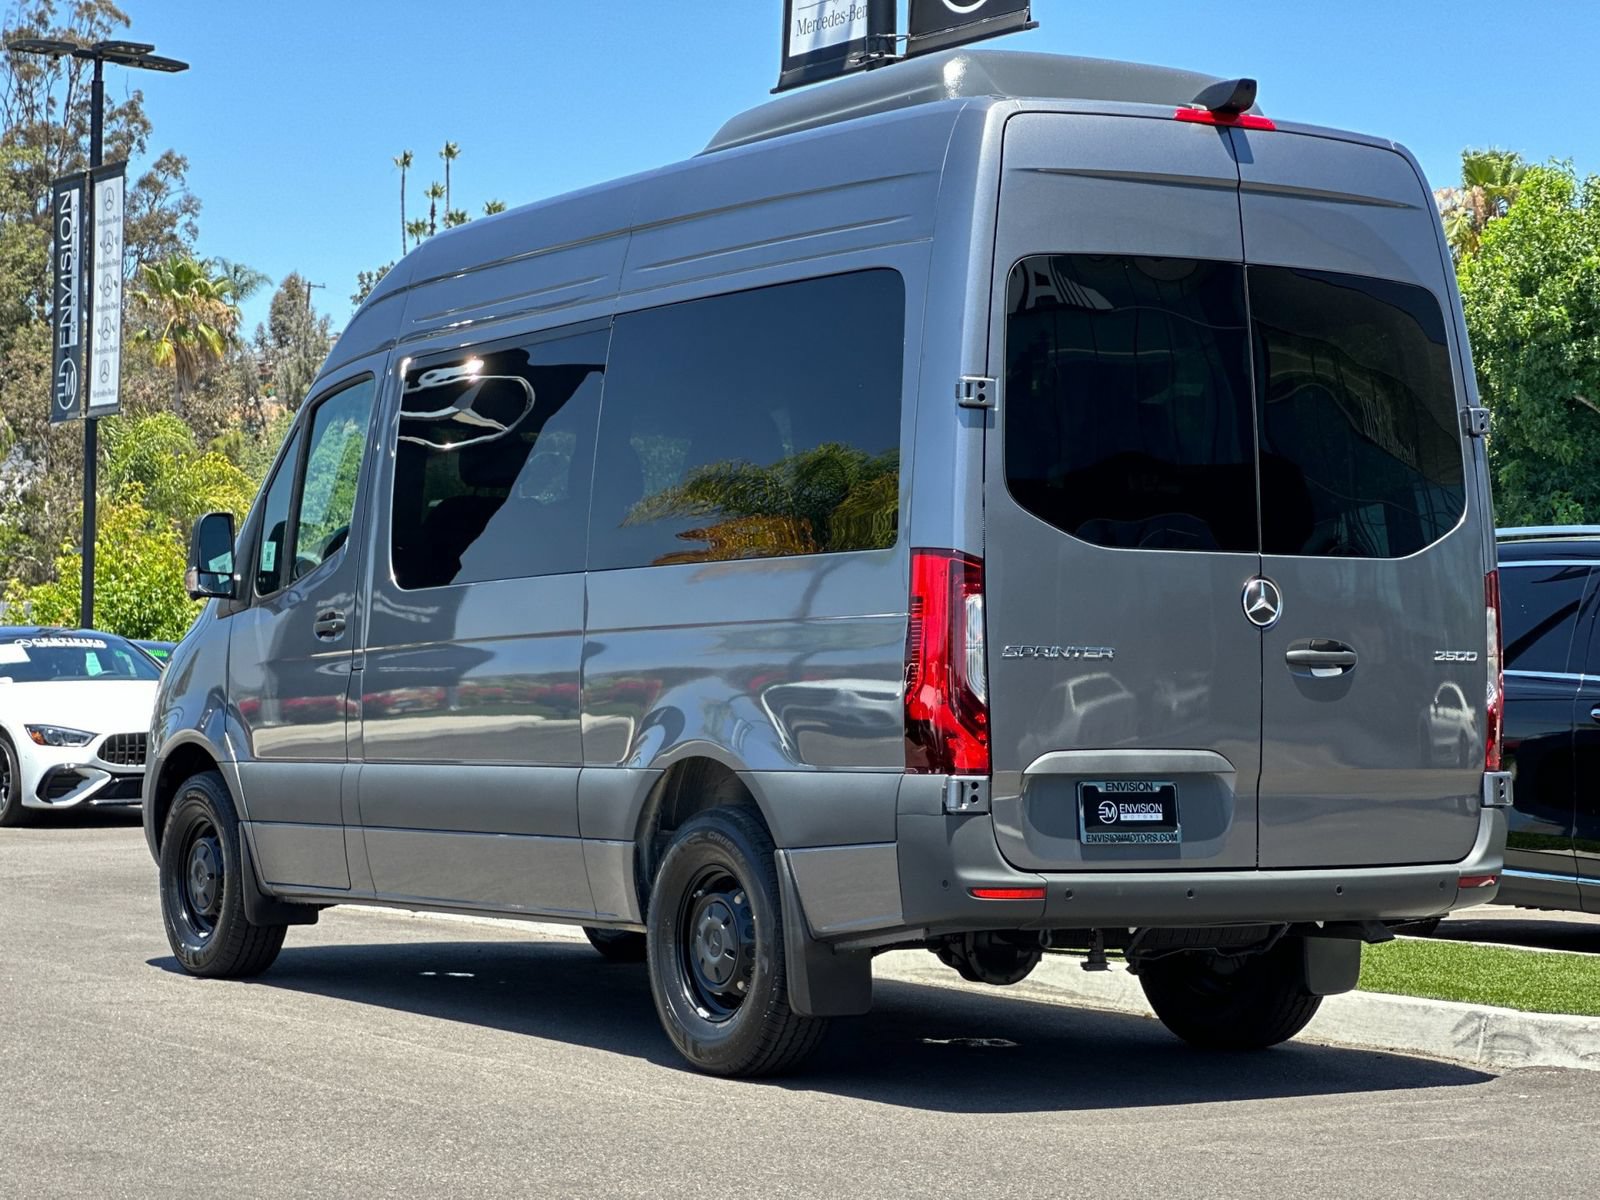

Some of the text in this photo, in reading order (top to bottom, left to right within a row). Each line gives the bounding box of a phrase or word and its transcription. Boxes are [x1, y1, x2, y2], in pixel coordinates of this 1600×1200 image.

[796, 4, 867, 36] Mercedes-Ben
[60, 191, 71, 348] ENVISION
[1002, 645, 1116, 658] SPRINTER
[1434, 650, 1478, 661] 2500
[1105, 782, 1153, 791] ENVISION
[1119, 803, 1163, 813] ENVISION
[1086, 834, 1178, 843] ENVISIONMOTORS.COM
